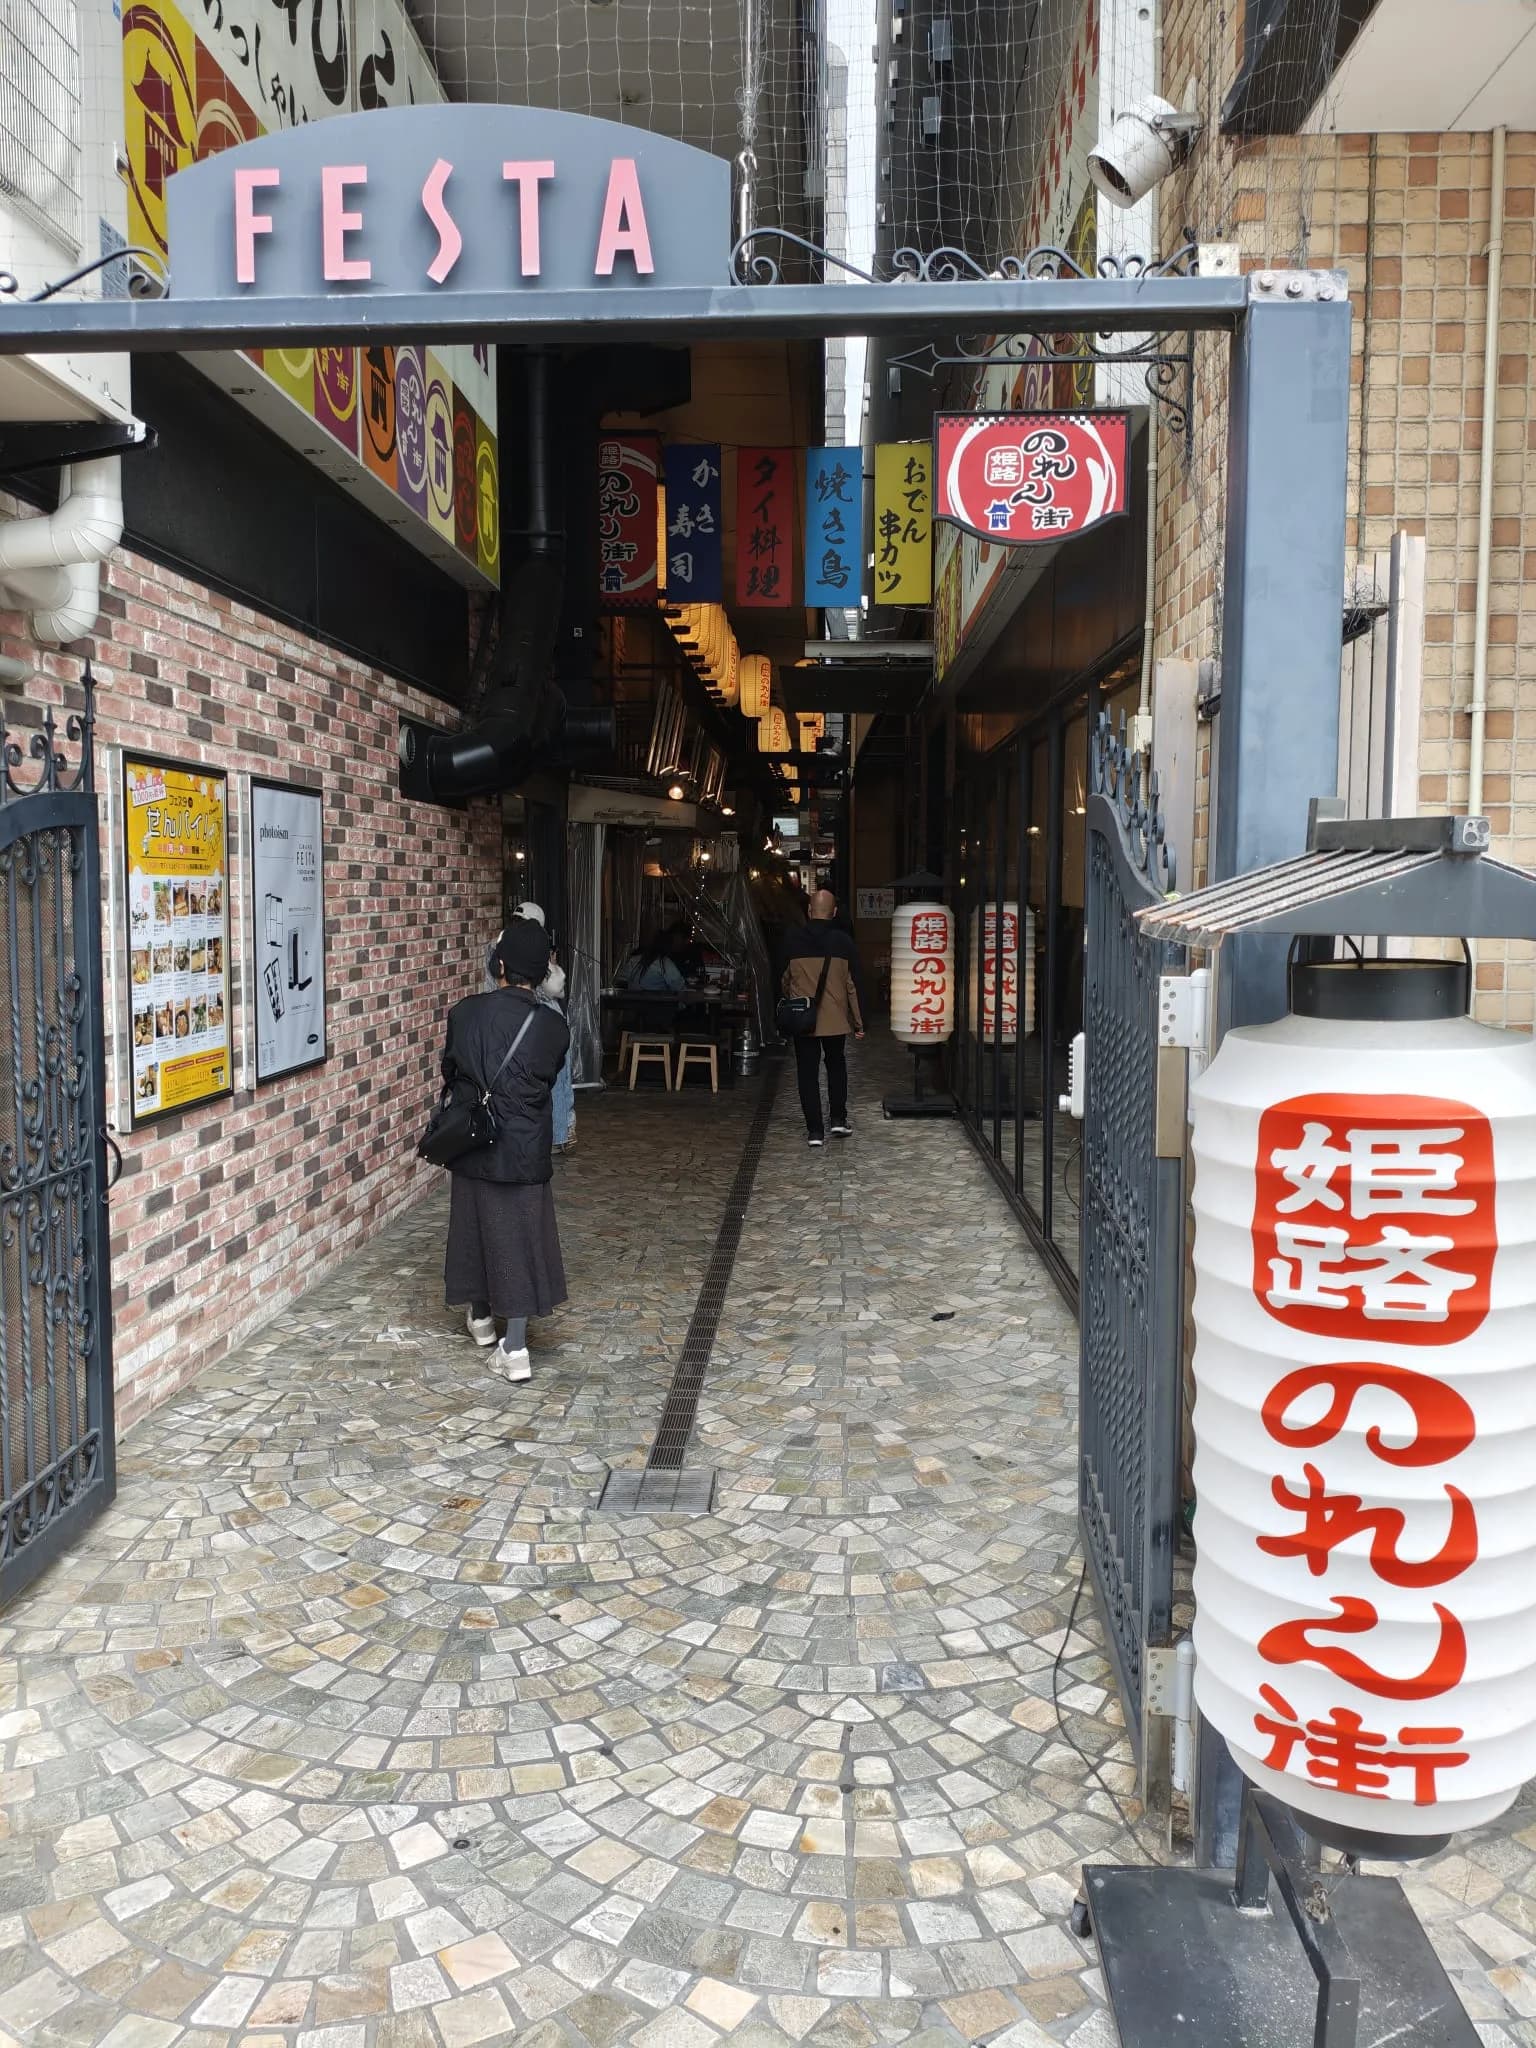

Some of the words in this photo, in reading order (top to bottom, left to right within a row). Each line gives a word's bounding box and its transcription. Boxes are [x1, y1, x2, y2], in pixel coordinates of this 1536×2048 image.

[235, 158, 654, 284] FESTA
[692, 458, 719, 533] かき
[901, 456, 928, 543] おでん
[991, 452, 1019, 481] 姫路
[668, 503, 695, 583] 寿司
[746, 456, 782, 598] タイ料理
[815, 462, 853, 589] 焼き鳥
[879, 509, 902, 593] 串カツ
[260, 824, 288, 842] photoism
